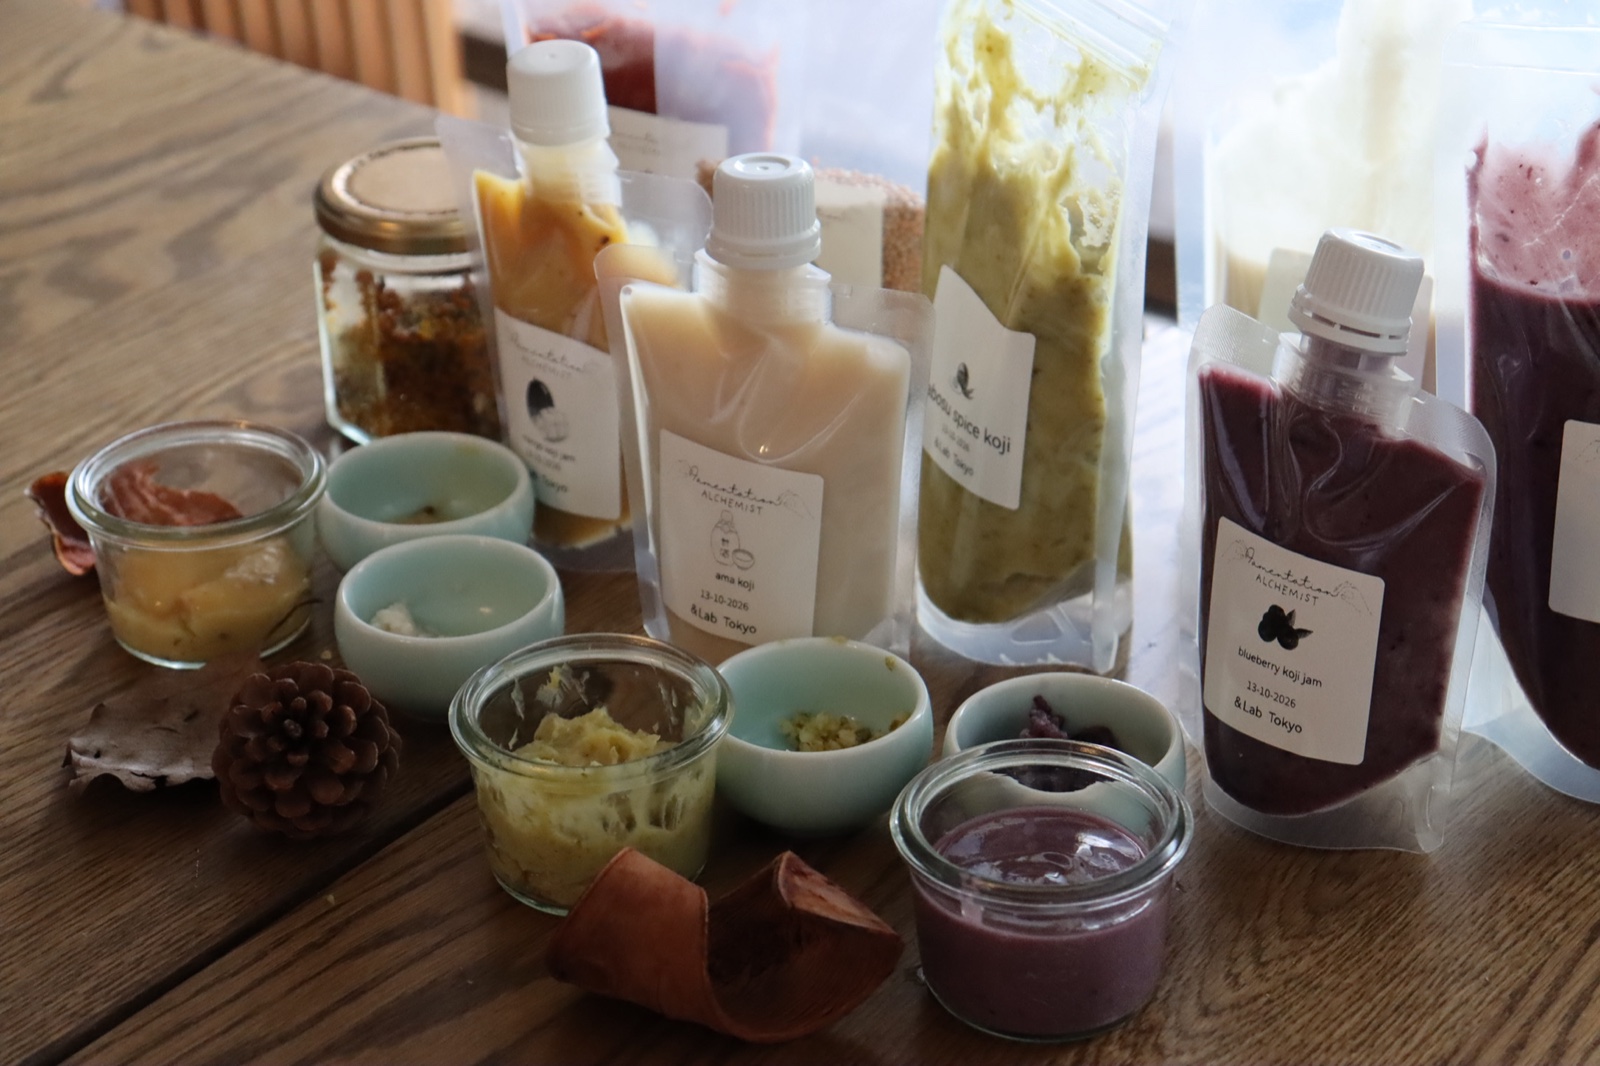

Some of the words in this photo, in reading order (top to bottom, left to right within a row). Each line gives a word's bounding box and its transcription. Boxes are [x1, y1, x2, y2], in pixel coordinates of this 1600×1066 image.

[952, 409, 980, 439] spice
[983, 426, 1011, 455] koji
[701, 489, 763, 515] ALCHEMIST
[715, 572, 735, 584] ama
[737, 577, 755, 592] koji
[1255, 573, 1319, 606] ALCHEMIST
[700, 588, 749, 612] 13-10-2026
[690, 603, 718, 624] &Lab
[723, 615, 757, 635] Tokyo
[1238, 645, 1280, 676] blueberry
[1282, 665, 1301, 683] koji
[1300, 673, 1323, 688] jam
[1246, 680, 1297, 709] 13-10-2026
[1234, 695, 1263, 719] &Lab
[1269, 711, 1303, 734] Tokyo
